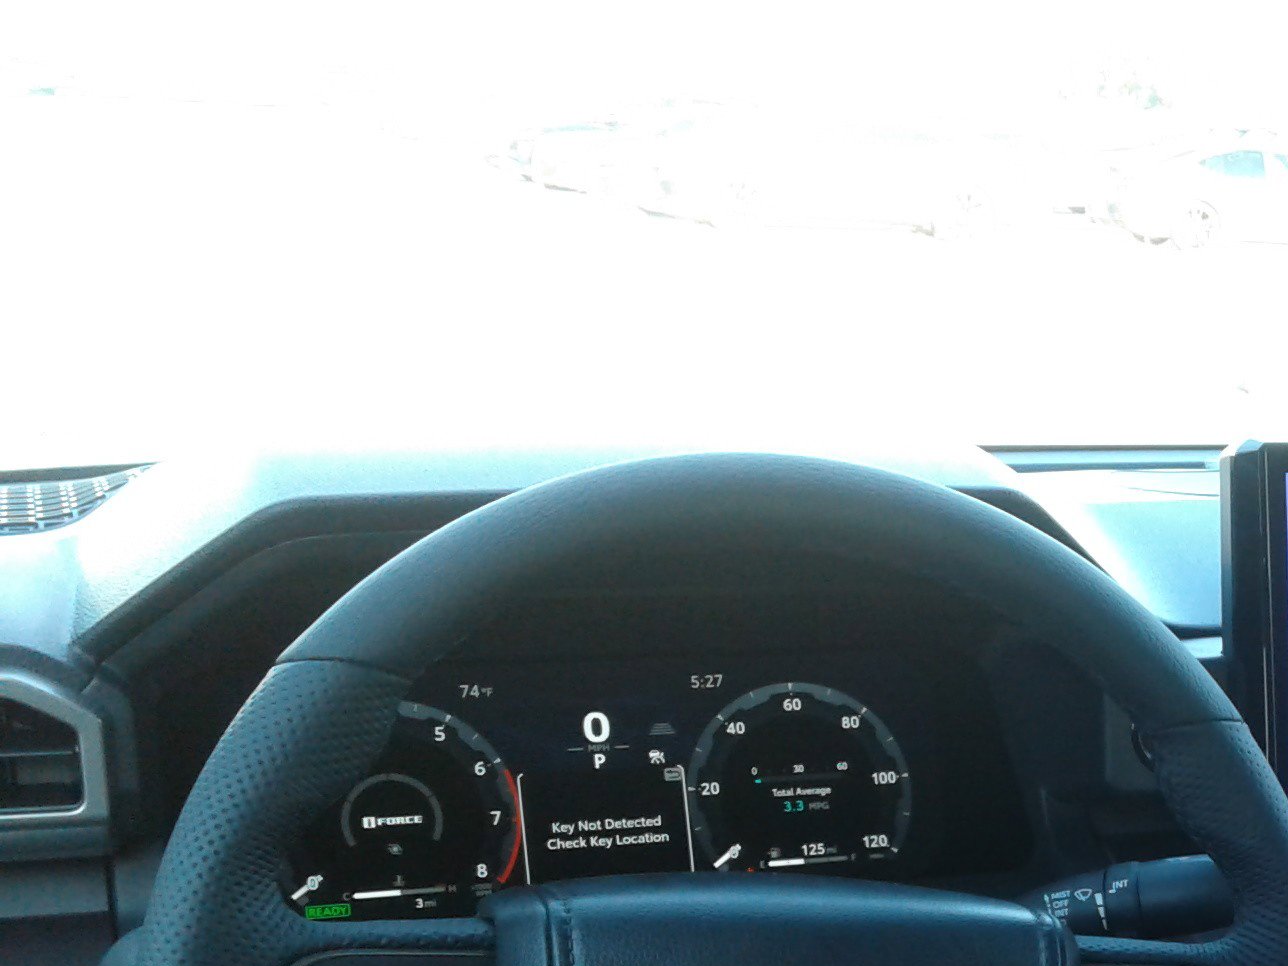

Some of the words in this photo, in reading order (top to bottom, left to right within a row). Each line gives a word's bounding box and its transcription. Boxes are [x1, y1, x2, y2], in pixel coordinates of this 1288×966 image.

[690, 674, 723, 689] 5:27
[783, 698, 801, 712] 60
[583, 712, 610, 743] 0
[726, 722, 746, 735] 40
[841, 716, 860, 729] 80
[434, 727, 446, 741] 5
[587, 744, 610, 752] MPH
[474, 761, 486, 775] 6
[594, 753, 606, 769] P
[872, 771, 897, 785] 100
[701, 782, 720, 795] 20
[772, 787, 794, 797] Total
[796, 786, 832, 797] Average
[783, 800, 804, 812] 3.3
[808, 801, 830, 811] MPG
[490, 811, 501, 826] 7
[552, 822, 575, 835] Key
[578, 820, 602, 832] Not
[605, 815, 662, 830] Detected
[547, 836, 587, 850] Check
[590, 835, 613, 849] Key
[616, 832, 670, 846] Location
[863, 835, 888, 848] 120
[801, 843, 826, 856] 125
[477, 863, 488, 878] 8
[416, 898, 424, 909] 3
[424, 899, 437, 909] mi
[308, 906, 347, 918] READY
